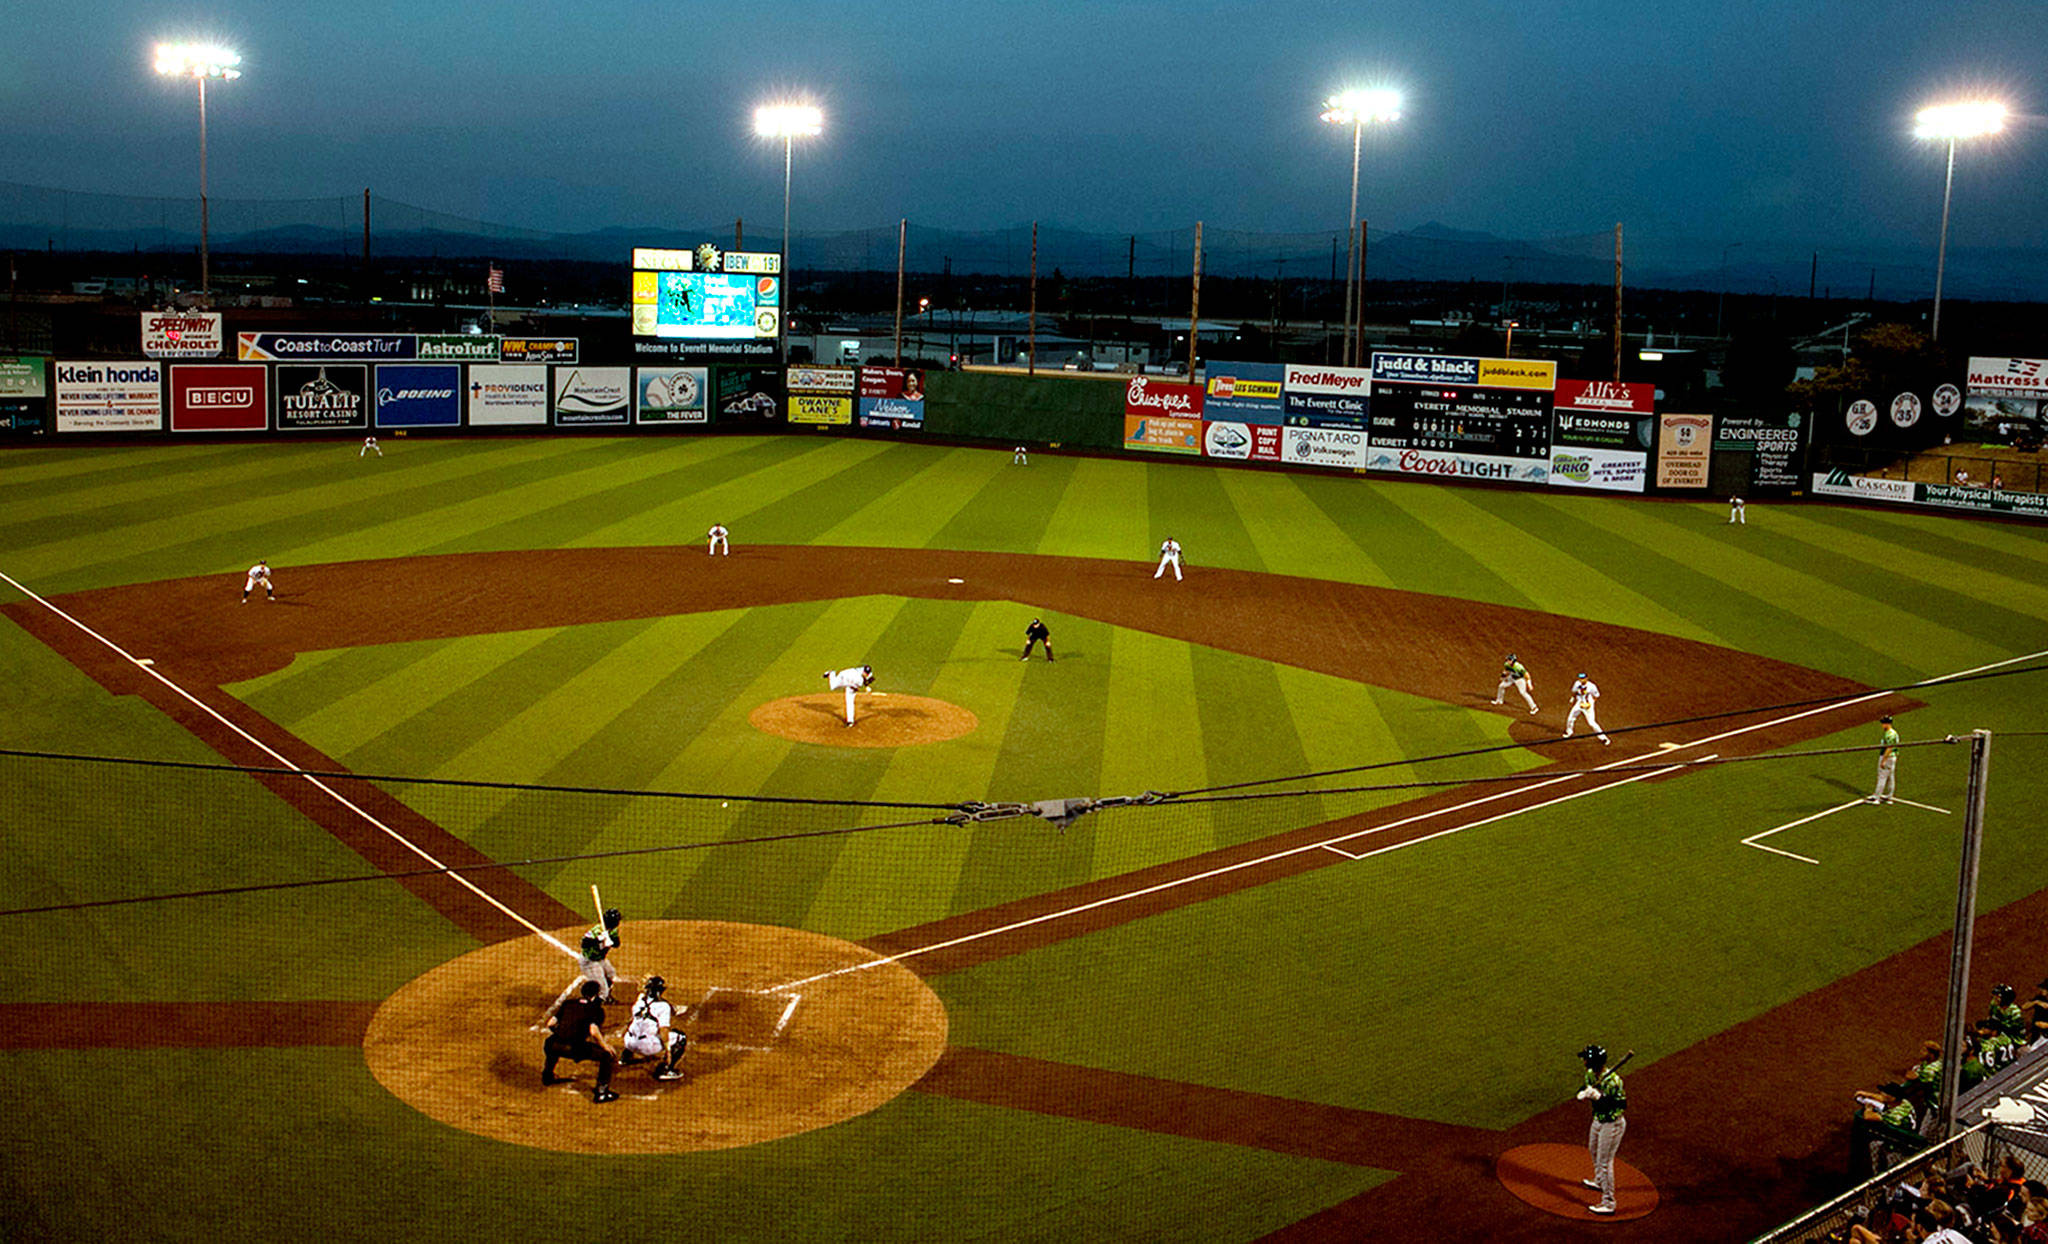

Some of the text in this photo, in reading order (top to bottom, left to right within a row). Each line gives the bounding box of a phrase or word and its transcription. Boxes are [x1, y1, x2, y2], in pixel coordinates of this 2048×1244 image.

[725, 254, 779, 271] IBEW 191
[148, 317, 216, 333] SPEEDWAY
[146, 340, 219, 350] CHEVROLET
[421, 341, 494, 355] AstroTurf
[635, 342, 774, 354] Welcome to Everett Memorial Stadium
[1375, 356, 1476, 375] judd & black
[1482, 367, 1548, 378] juddblack.com
[57, 366, 159, 383] klein honda
[1288, 371, 1364, 390] Fred Meyer
[1969, 373, 2041, 387] Mattress
[396, 389, 452, 399] BOEING
[484, 384, 545, 392] PROVIDENCE
[1581, 381, 1631, 399] Alfy's
[283, 393, 361, 410] TULALIP
[797, 398, 841, 408] DWAYNE
[1289, 395, 1364, 411] The Everett Clinic
[286, 410, 358, 419] RESORT CASINO
[666, 411, 681, 420] THE
[682, 411, 703, 420] FEVER
[1414, 402, 1543, 417] EVERETT MEMORIAL STADIUM
[1896, 409, 1913, 422] 35
[1575, 419, 1630, 430] EDMONDS
[1721, 417, 1753, 427] Powered
[1257, 427, 1278, 437] PRINT
[1289, 429, 1361, 445] PIGNATARO
[1516, 428, 1523, 438] 2
[1719, 427, 1799, 441] ENGINEERED
[1257, 436, 1278, 446] COPY
[1371, 438, 1408, 448] EVERETT
[1540, 447, 1547, 456] 0
[1756, 440, 1799, 452] SPORTS
[1399, 448, 1513, 478] Coors LIGHT
[1551, 462, 1590, 474] KRKO
[1856, 477, 1907, 493] CASCADE
[1925, 484, 1948, 497] Your
[1949, 484, 1992, 502] Physical
[1992, 489, 2045, 506] Therapists
[1978, 1051, 1995, 1068] 16
